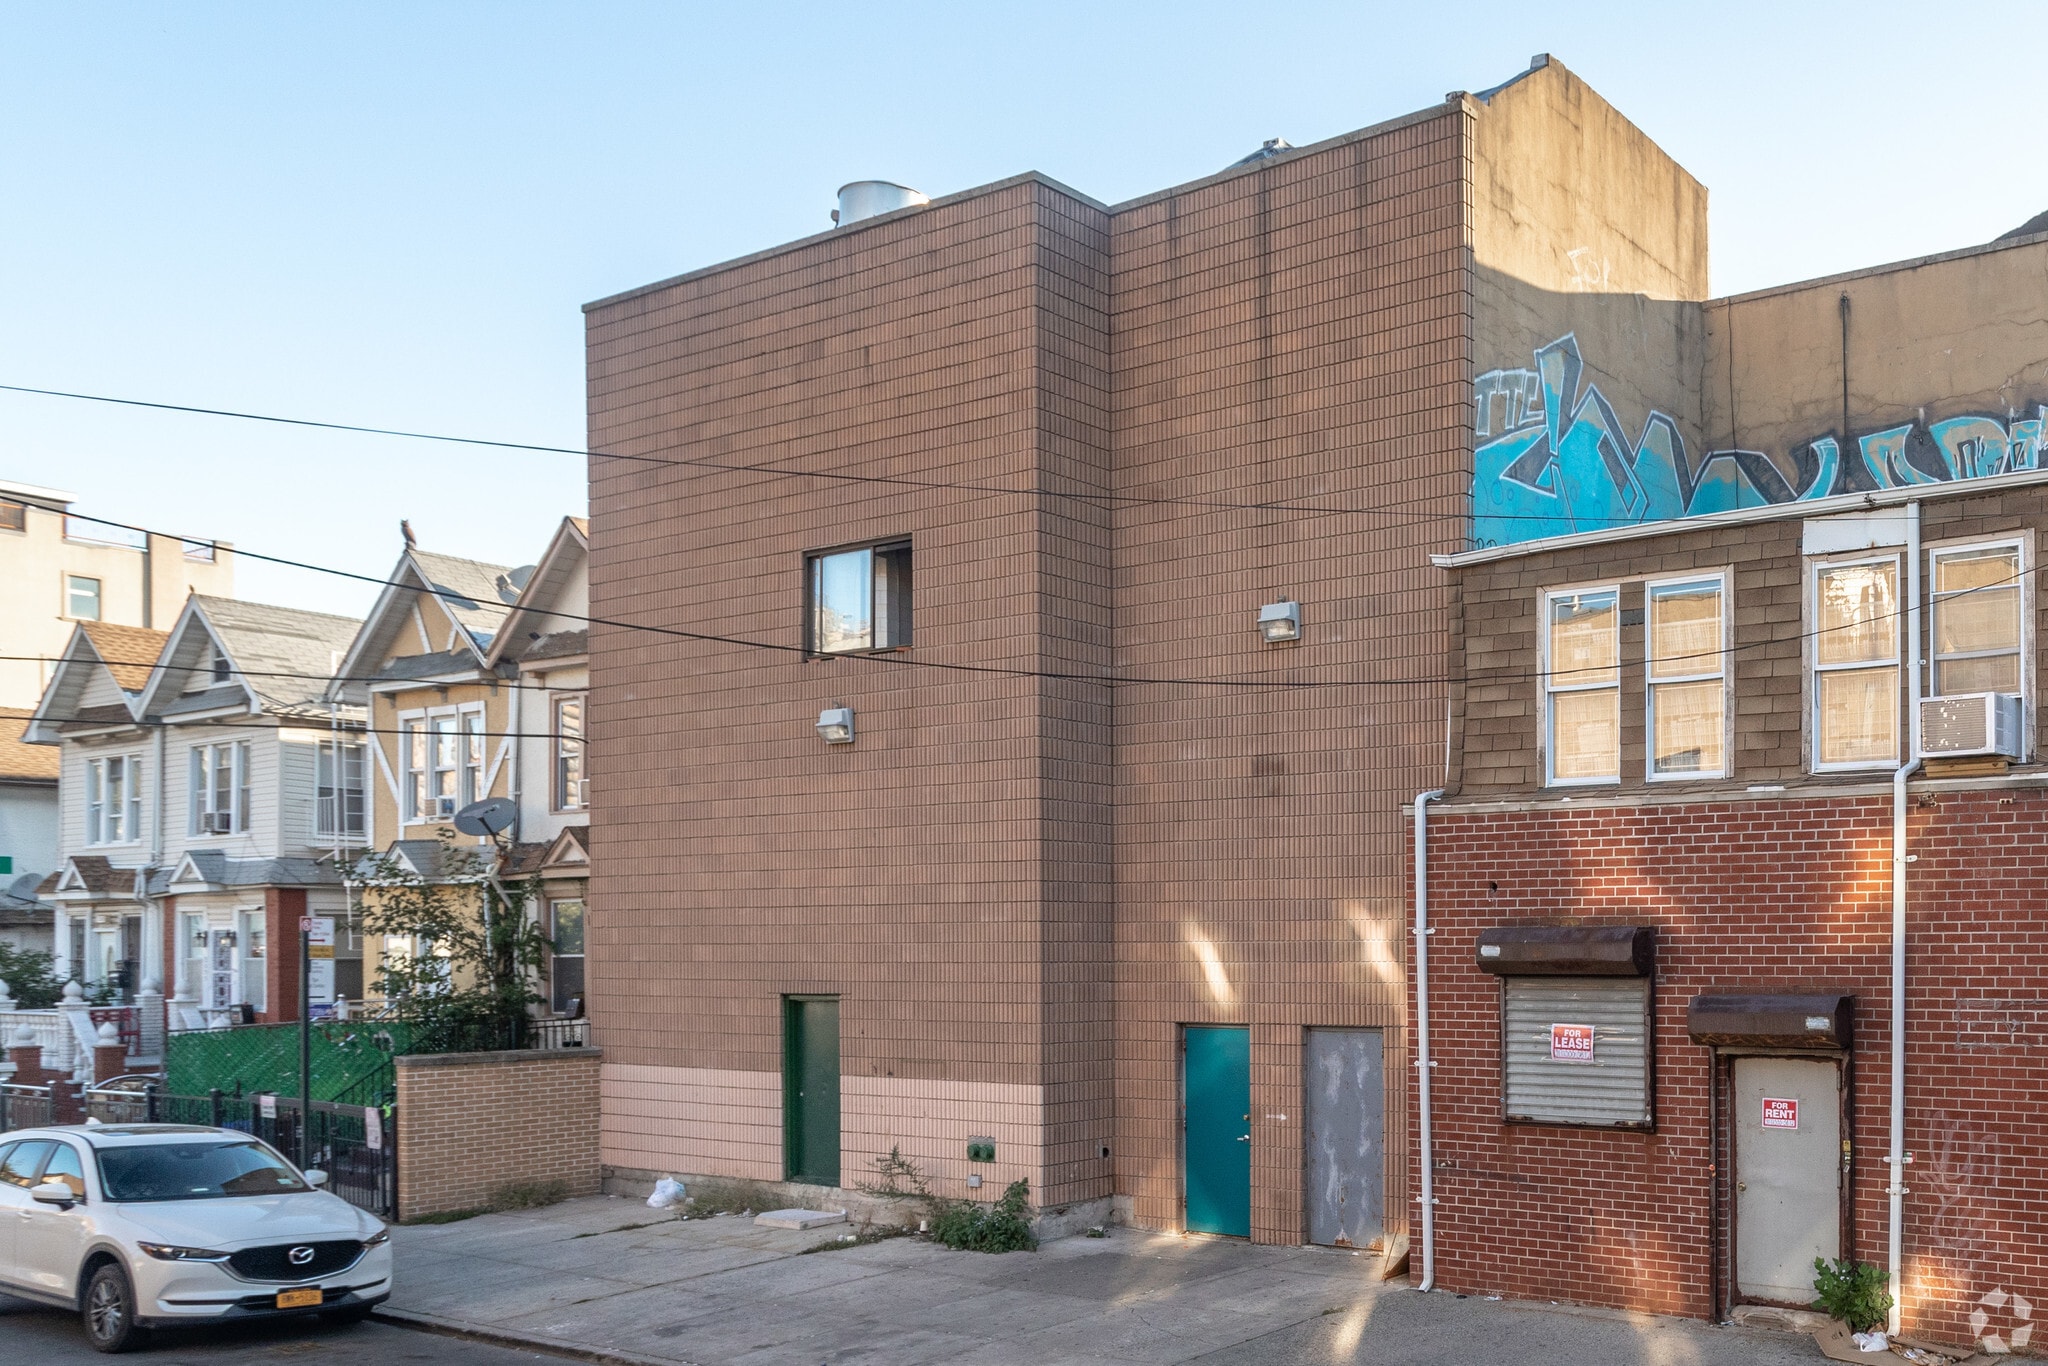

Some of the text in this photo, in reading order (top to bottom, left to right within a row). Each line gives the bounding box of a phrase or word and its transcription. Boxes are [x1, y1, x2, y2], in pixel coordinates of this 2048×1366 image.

[1564, 1029, 1581, 1038] FOR
[1555, 1037, 1590, 1049] LEASE
[1771, 1102, 1788, 1110] FOR
[1765, 1109, 1794, 1119] RENT
